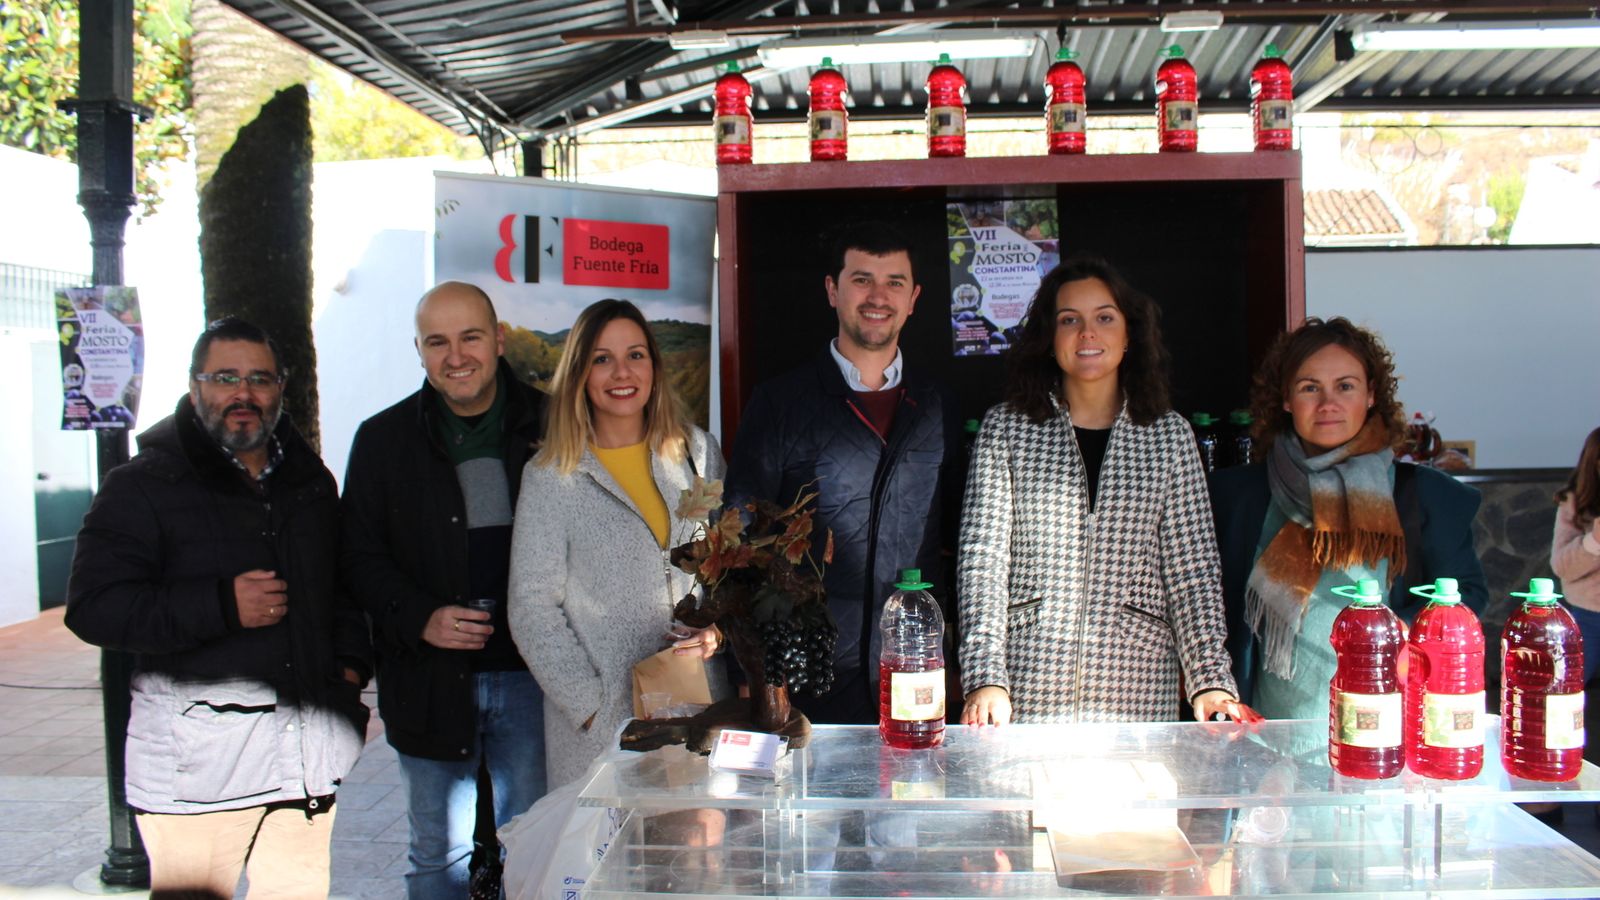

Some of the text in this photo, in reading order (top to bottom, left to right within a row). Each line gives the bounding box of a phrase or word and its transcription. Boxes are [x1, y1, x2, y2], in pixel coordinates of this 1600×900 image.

[973, 229, 997, 241] VII
[589, 236, 644, 256] Bodega
[982, 242, 1021, 252] Feria
[976, 252, 1036, 266] MOSTO
[573, 256, 659, 274] Fuente Fría
[974, 265, 1036, 274] CONSTANTINA
[80, 313, 97, 323] VII
[86, 325, 116, 334] Feria
[81, 336, 129, 347] MOSTO
